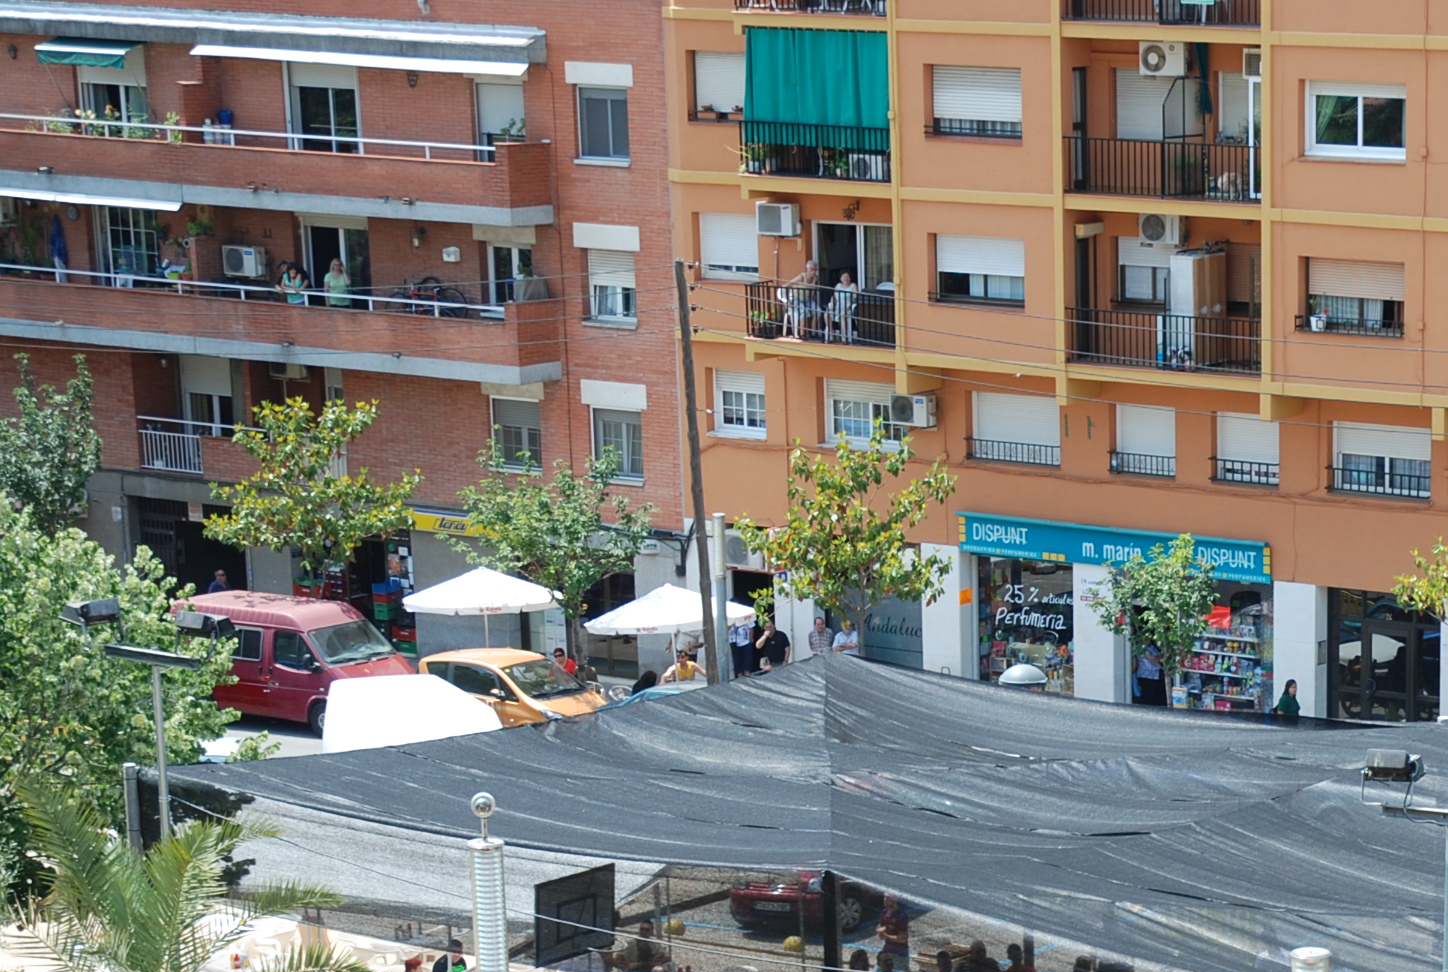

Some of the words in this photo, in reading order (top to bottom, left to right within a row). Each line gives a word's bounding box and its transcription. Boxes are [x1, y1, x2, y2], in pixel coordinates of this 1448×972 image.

[972, 522, 1028, 545] DISPUNT
[1198, 546, 1256, 570] DISPUNT
[1003, 584, 1025, 604] 25
